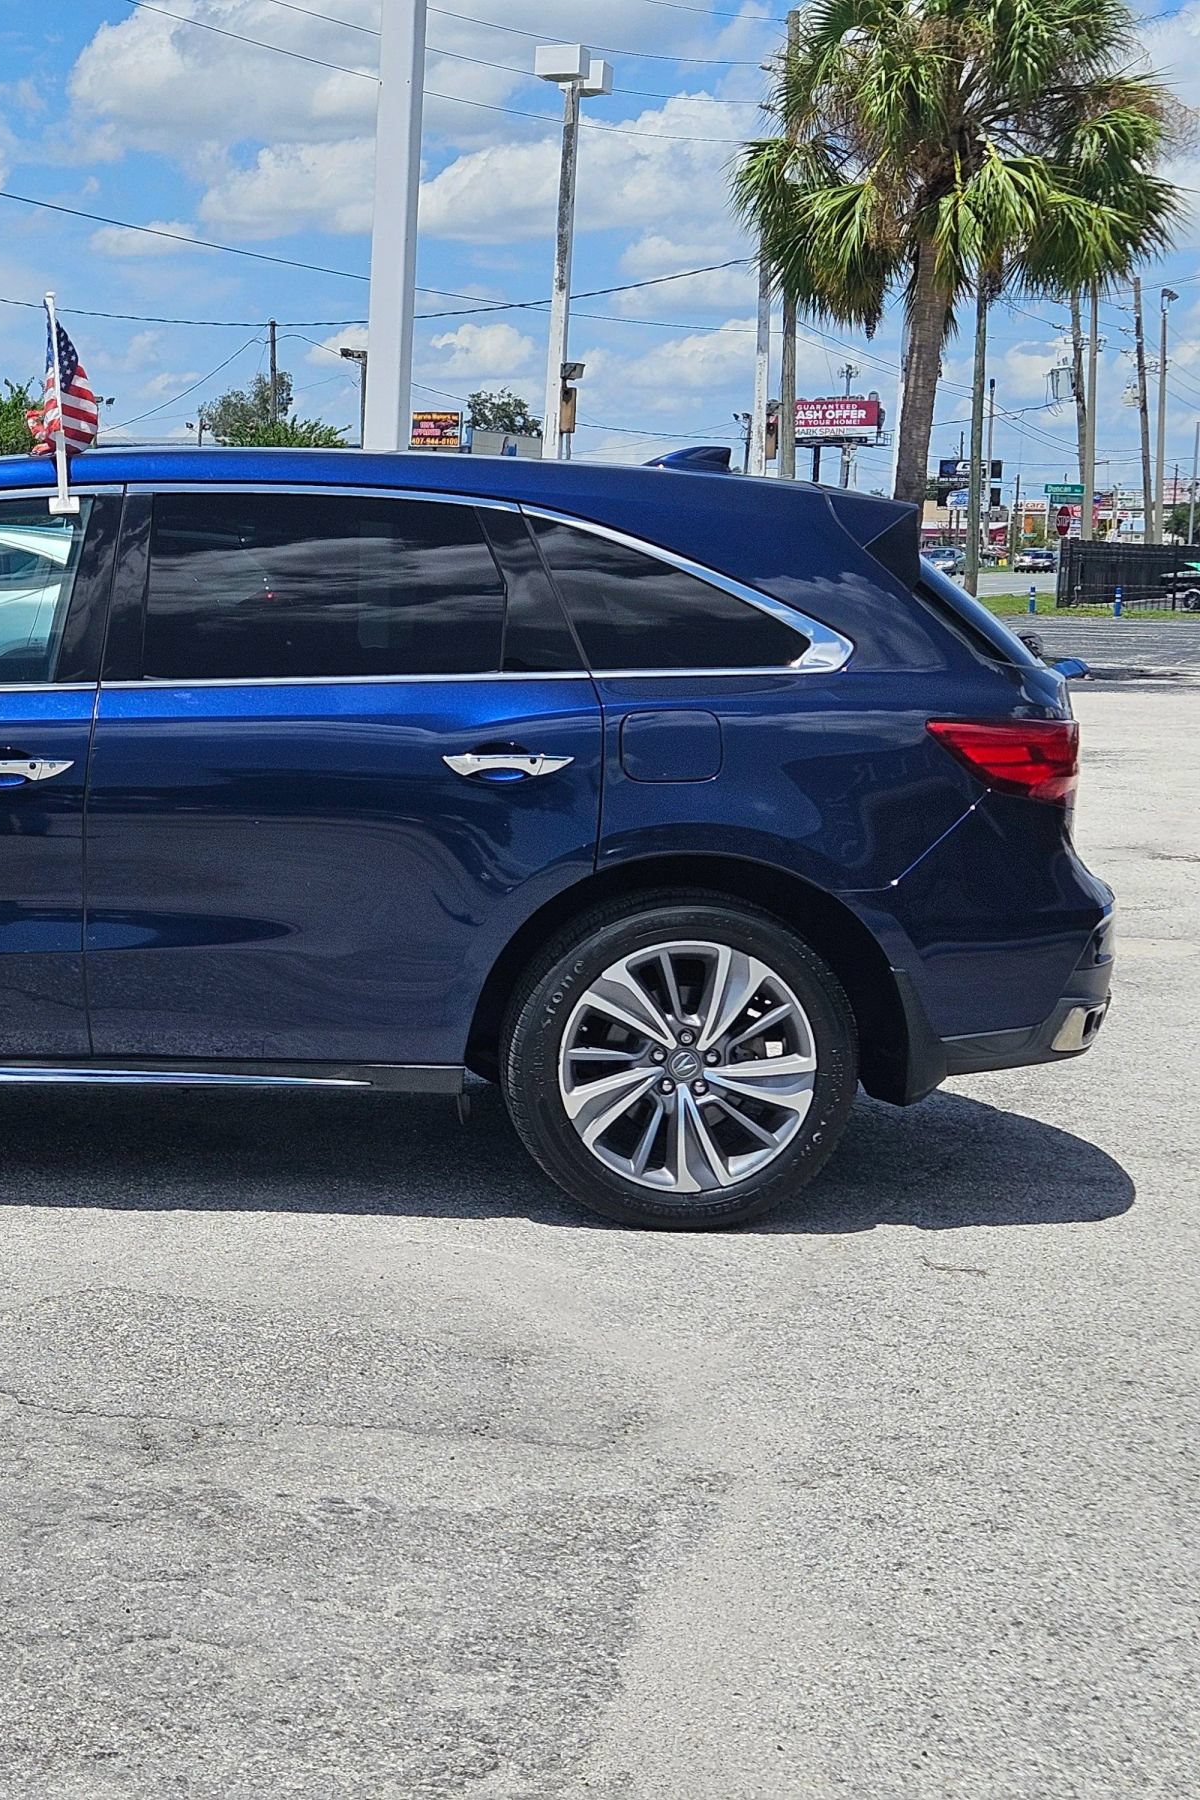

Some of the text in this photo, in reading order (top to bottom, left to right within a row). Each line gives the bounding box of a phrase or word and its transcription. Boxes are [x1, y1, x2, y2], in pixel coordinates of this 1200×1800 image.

[795, 410, 867, 419] ASH OFFER
[819, 427, 846, 435] SPAIN
[1047, 485, 1072, 493] Duncan
[1057, 516, 1070, 527] STOP
